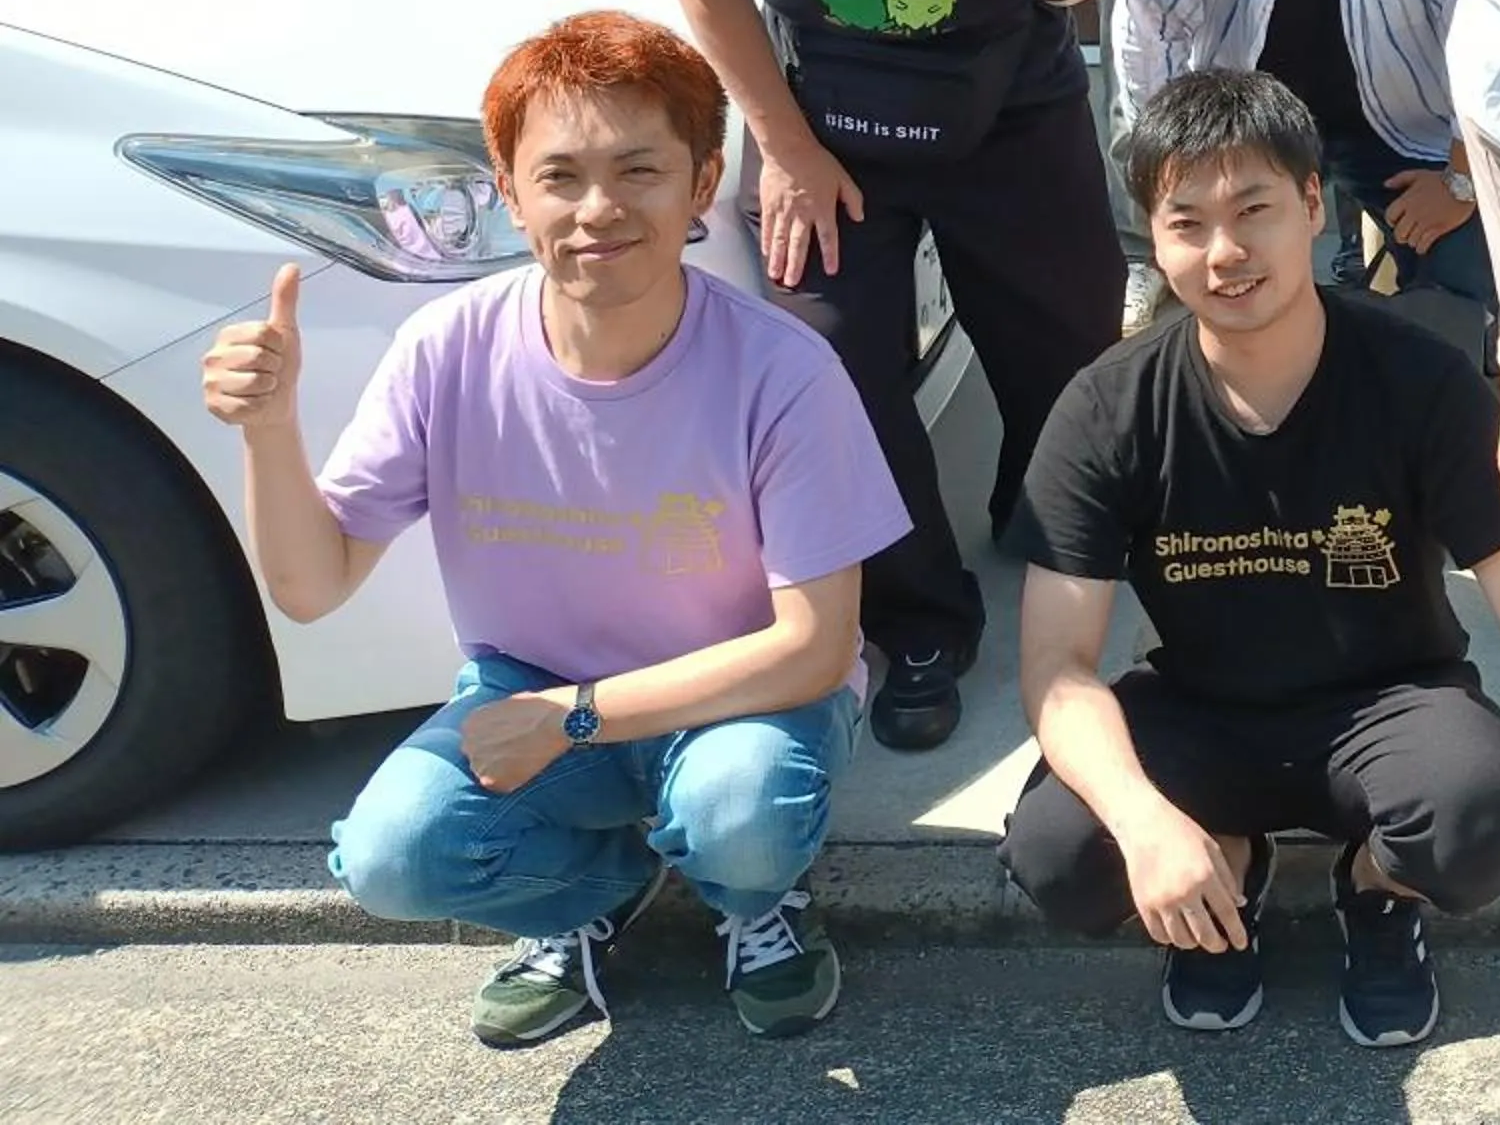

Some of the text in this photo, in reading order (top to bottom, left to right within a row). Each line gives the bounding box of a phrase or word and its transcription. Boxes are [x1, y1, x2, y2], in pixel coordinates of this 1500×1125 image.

[874, 122, 890, 136] is
[1155, 526, 1309, 557] Shironoshita
[1164, 556, 1312, 583] Guesthouse
